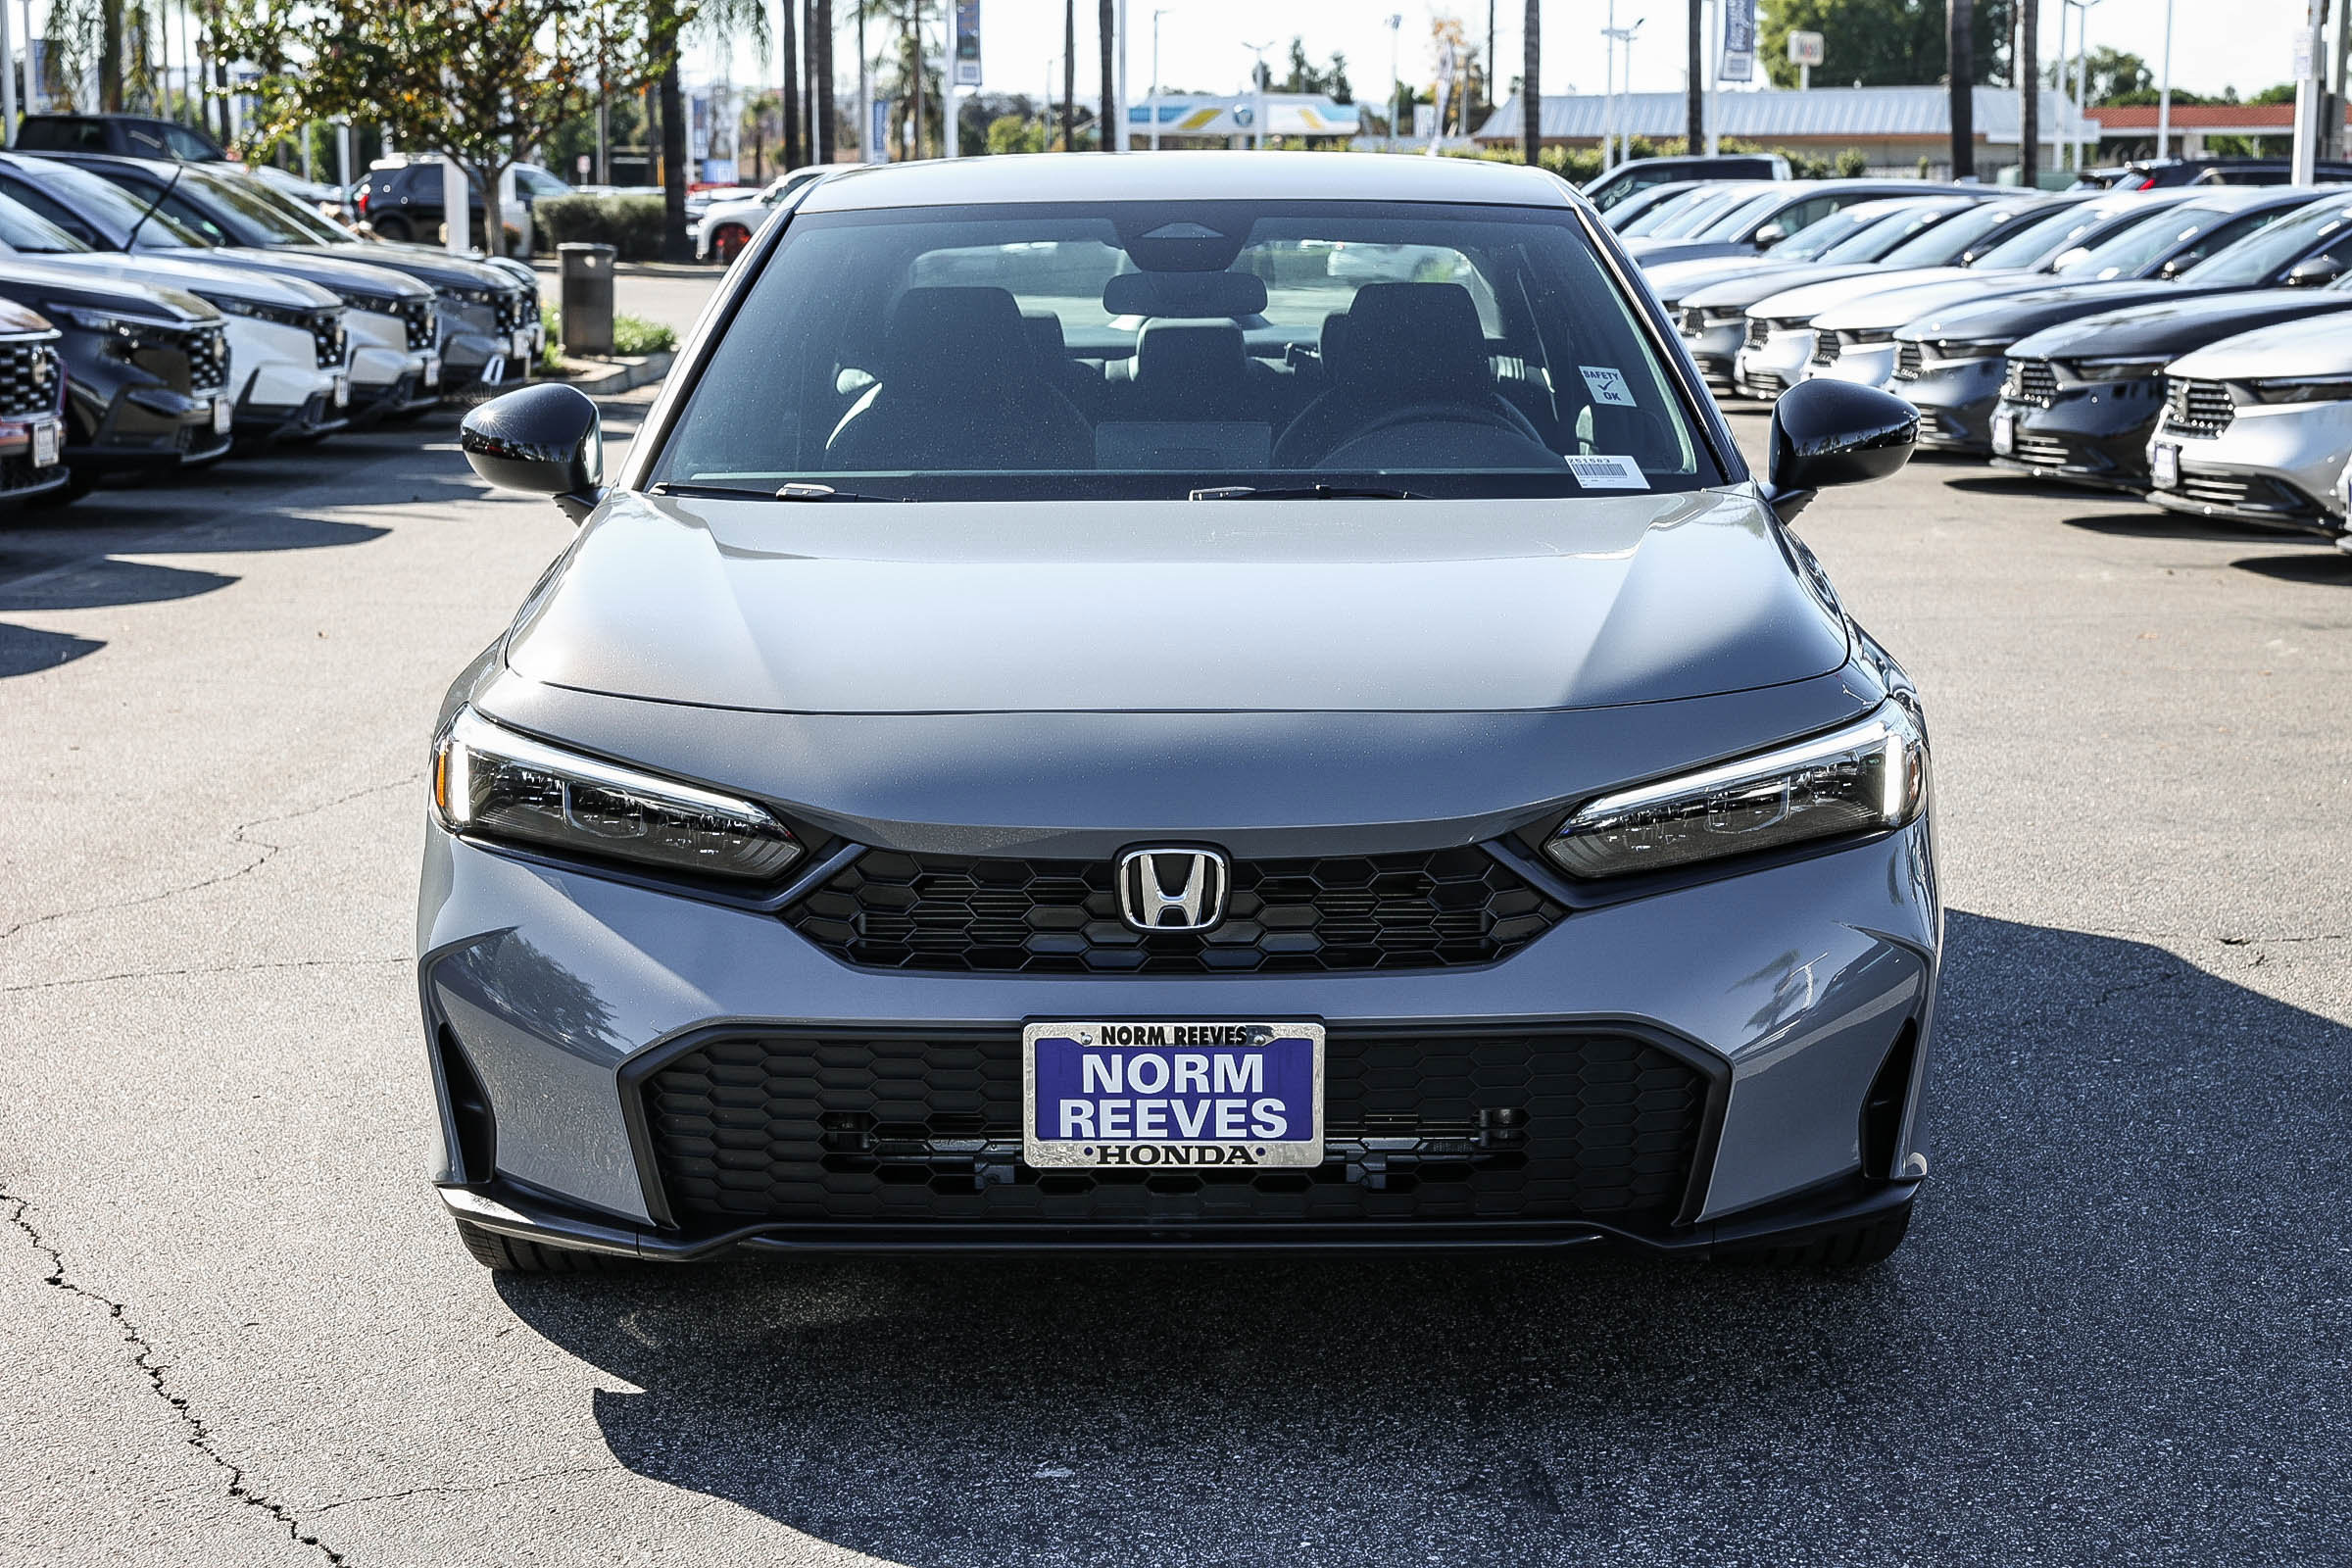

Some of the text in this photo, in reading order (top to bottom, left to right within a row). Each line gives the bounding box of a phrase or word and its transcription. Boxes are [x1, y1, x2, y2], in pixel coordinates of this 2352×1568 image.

[1582, 369, 1619, 380] SAFETY
[1603, 392, 1622, 401] OK
[1101, 1025, 1248, 1046] NORM REEVES
[1082, 1054, 1264, 1095] NORM
[1059, 1098, 1288, 1139] REEVES
[1096, 1144, 1258, 1165] HONDA
